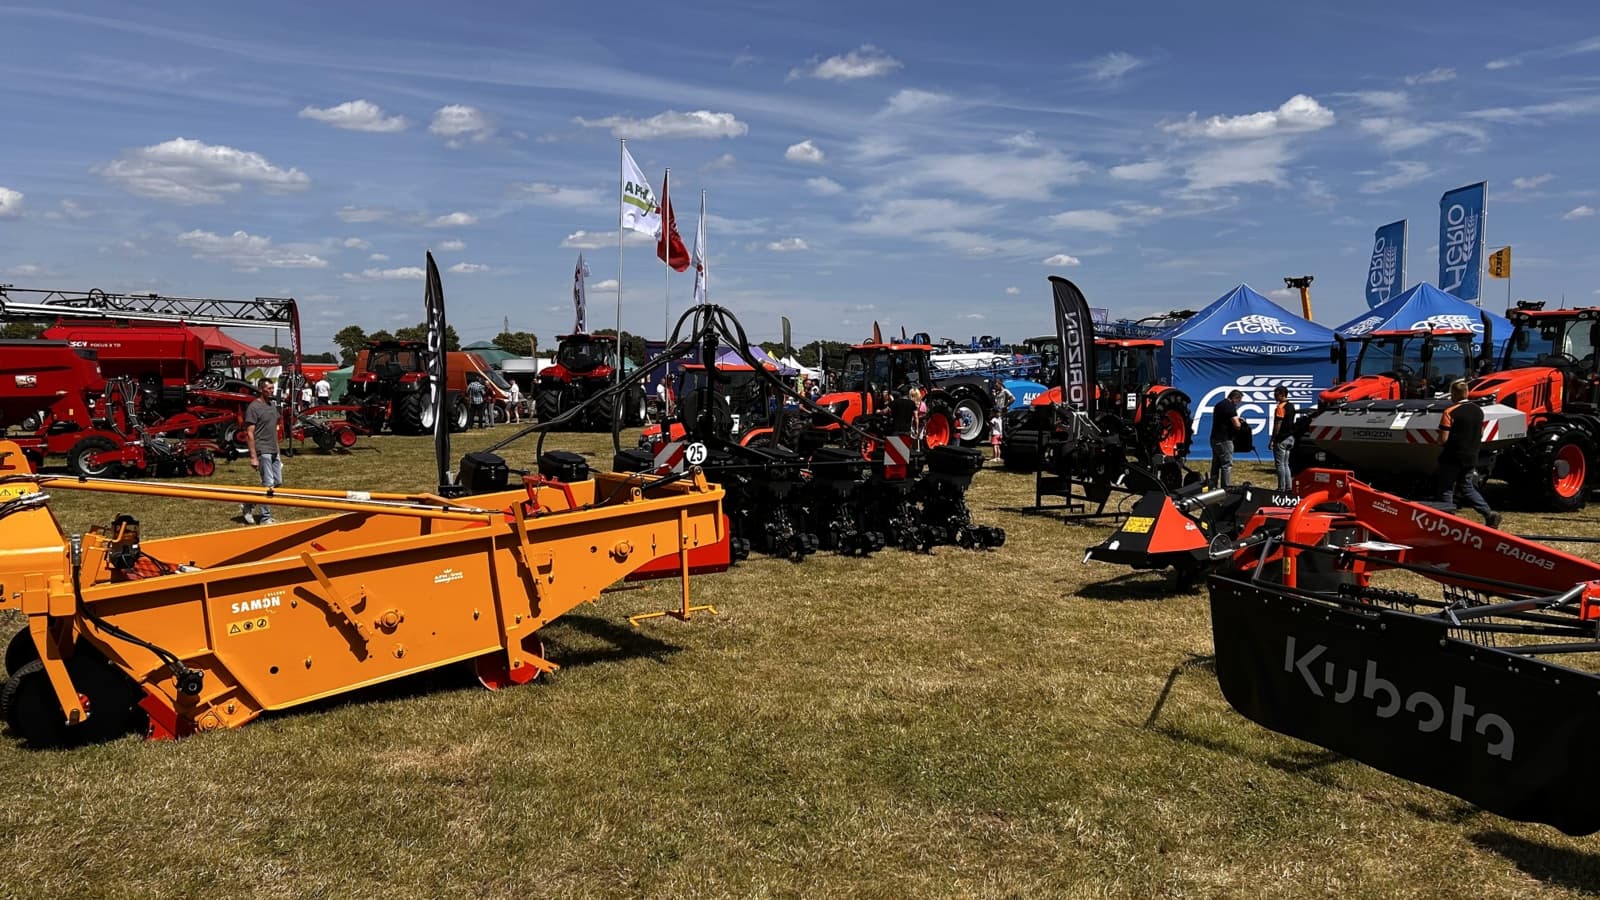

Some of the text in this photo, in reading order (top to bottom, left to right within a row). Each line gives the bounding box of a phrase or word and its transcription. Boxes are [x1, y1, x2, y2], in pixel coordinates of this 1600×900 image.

[1222, 318, 1297, 335] AGRIO
[1231, 345, 1300, 355] www.agrio.cz
[690, 445, 703, 461] 25
[1272, 495, 1301, 506] Kubot
[1411, 509, 1556, 570] Kubota RA1043
[231, 596, 280, 614] SAMON
[1284, 635, 1515, 761] Kubota
